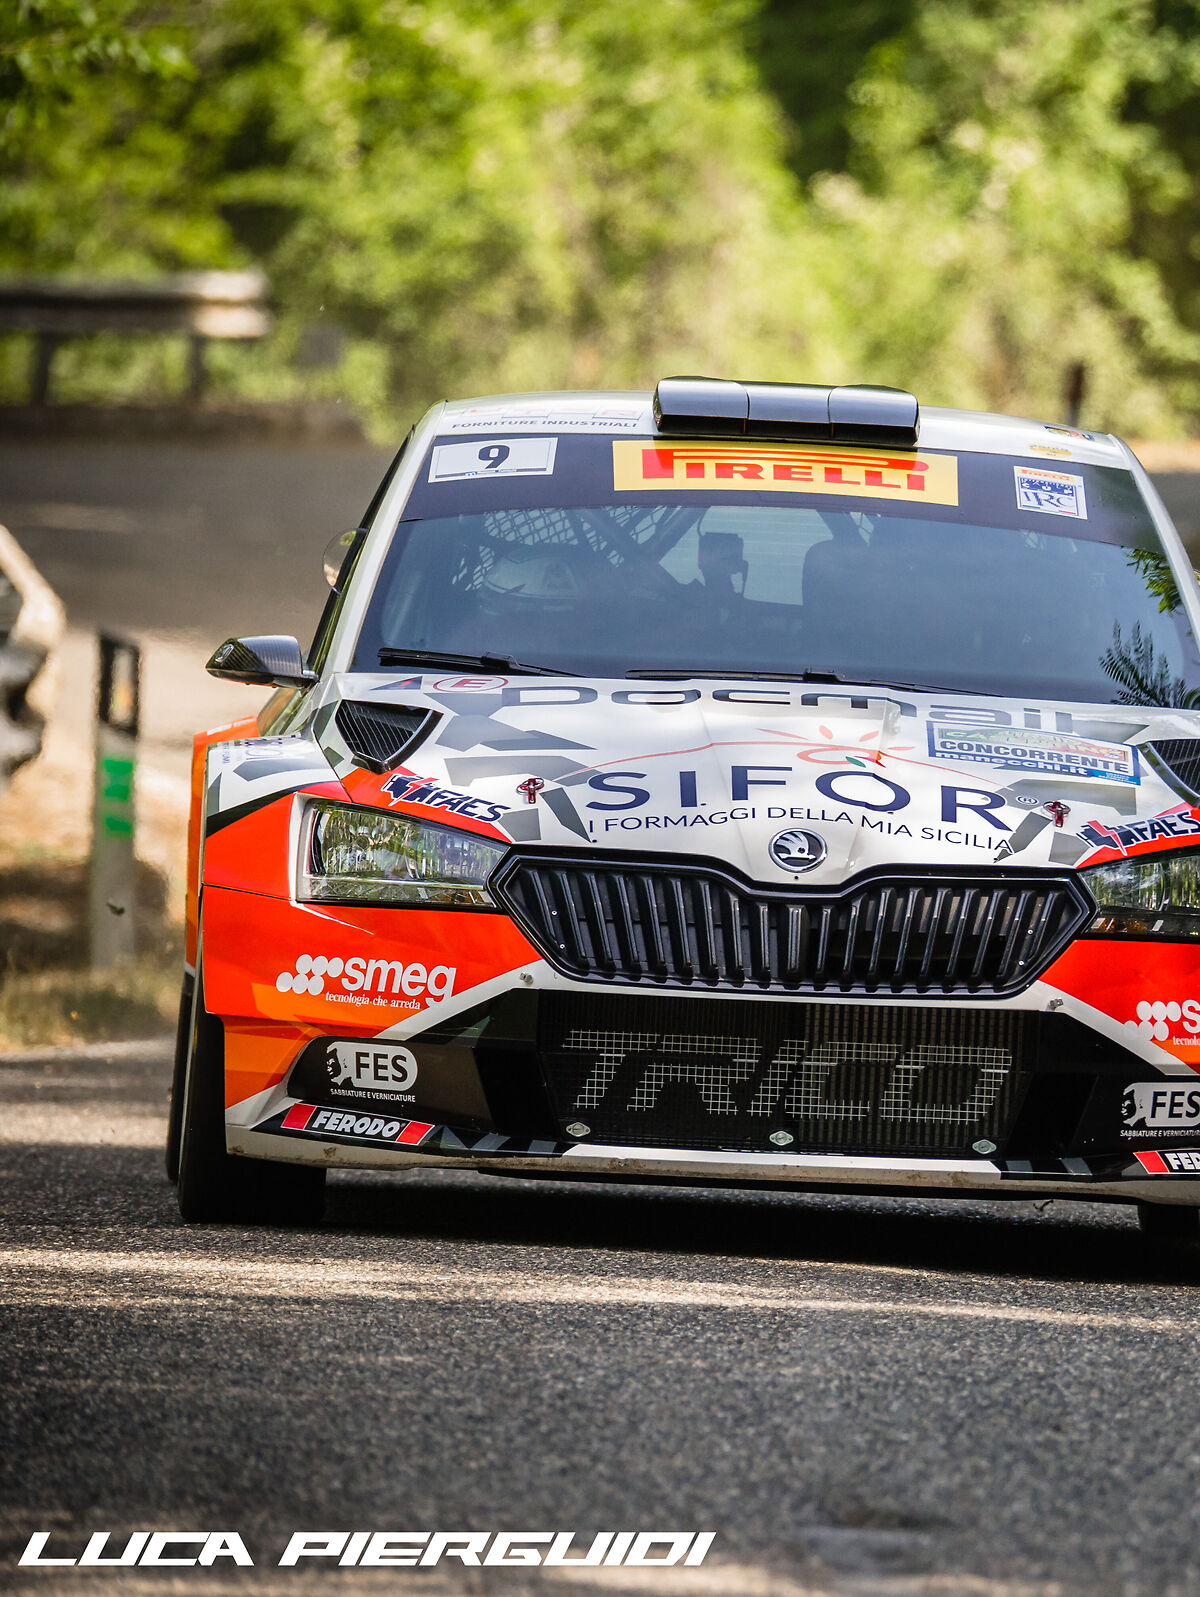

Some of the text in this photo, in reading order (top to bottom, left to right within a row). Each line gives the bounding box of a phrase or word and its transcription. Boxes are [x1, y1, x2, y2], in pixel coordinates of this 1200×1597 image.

[452, 420, 637, 429] FORNITURE INDUSTRIALI
[478, 445, 510, 469] 9
[642, 449, 929, 491] PIRELLI
[450, 679, 493, 688] E
[502, 686, 1073, 734] Docmail
[940, 740, 1128, 774] CONCORRENTE
[589, 807, 1013, 853] I FORMAGGI DELLA MIA SICILIA
[341, 957, 456, 1009] smeg
[325, 991, 421, 1010] tecnologia che arreda
[355, 1052, 408, 1083] FES
[561, 1029, 1013, 1125] TRICO
[330, 1088, 366, 1098] SABBIATURE
[372, 1091, 416, 1102] VERNICIATURE
[312, 1110, 400, 1138] FERODO
